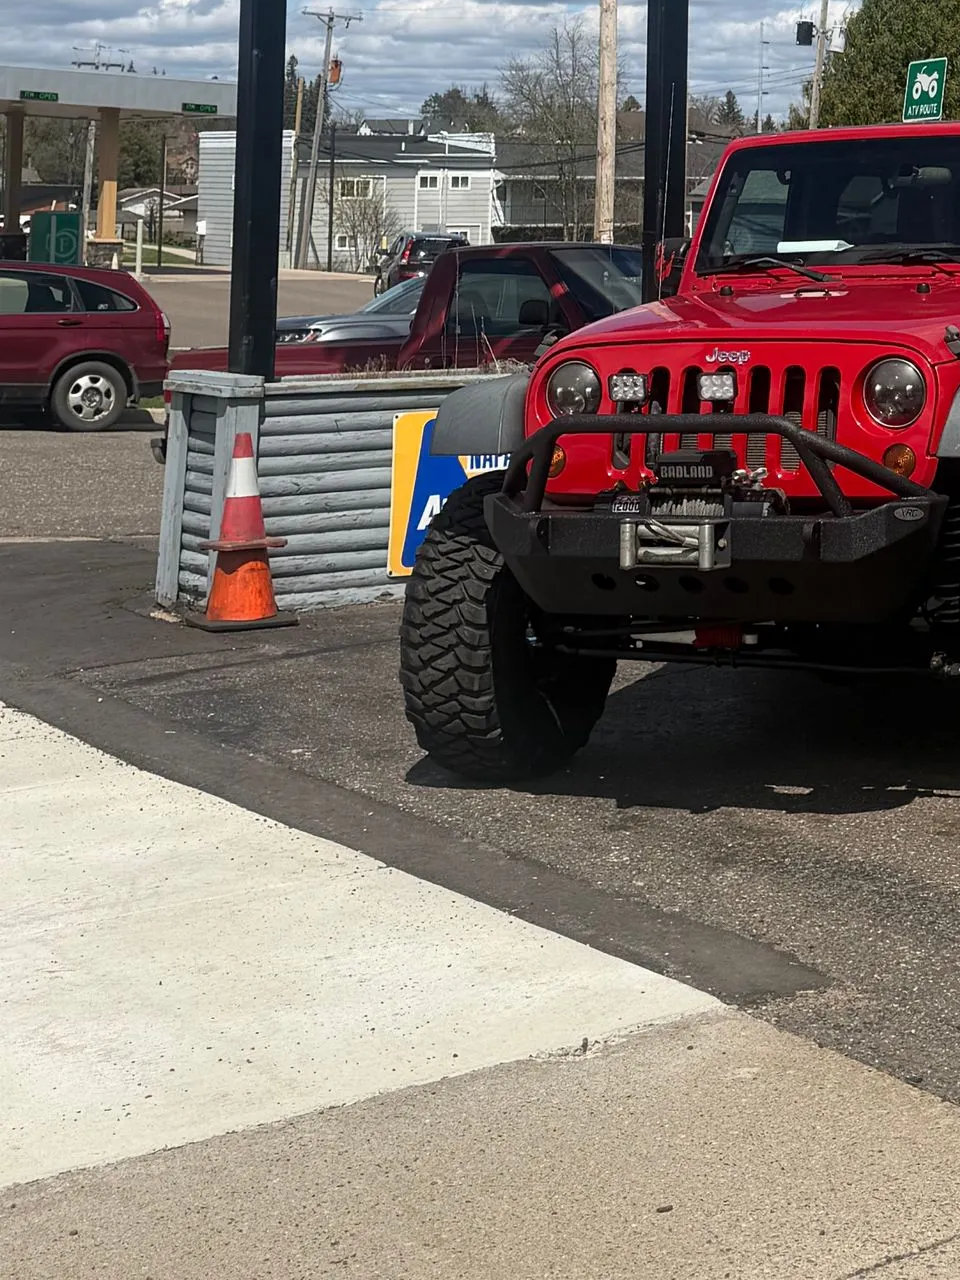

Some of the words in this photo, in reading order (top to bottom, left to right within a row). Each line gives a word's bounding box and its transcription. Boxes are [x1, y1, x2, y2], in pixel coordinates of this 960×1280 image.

[908, 105, 920, 116] ATV
[920, 103, 938, 115] ROUTE
[705, 346, 751, 365] Jeep
[660, 465, 714, 478] BADLAND
